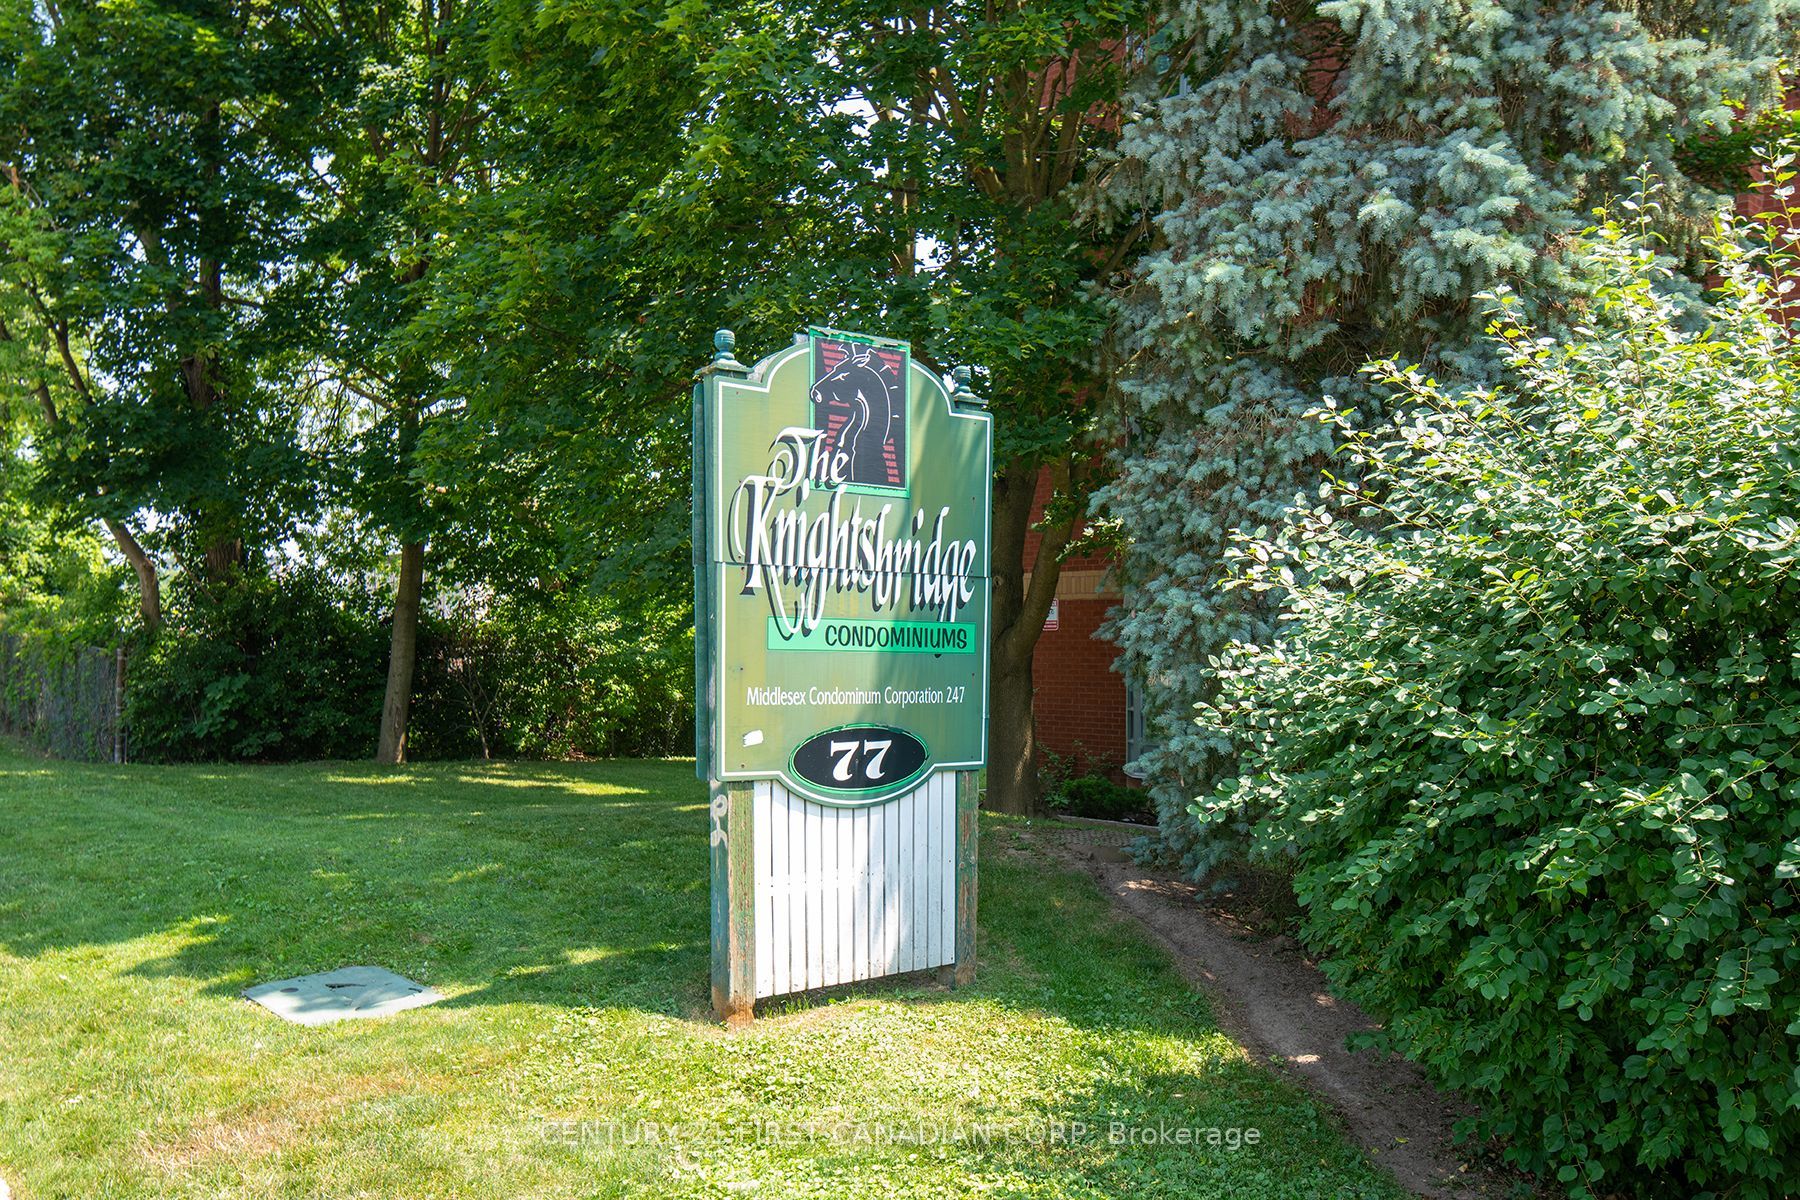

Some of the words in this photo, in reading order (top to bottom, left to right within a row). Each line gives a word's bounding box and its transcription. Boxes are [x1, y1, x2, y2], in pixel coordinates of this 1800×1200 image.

[771, 426, 850, 489] The
[733, 474, 977, 632] Knightsbridge
[824, 624, 968, 649] CONDOMINIUMS
[746, 686, 806, 706] Middlesex
[808, 686, 881, 706] Condominum
[884, 686, 943, 709] Corporation
[946, 686, 965, 704] 247
[830, 739, 892, 781] 77
